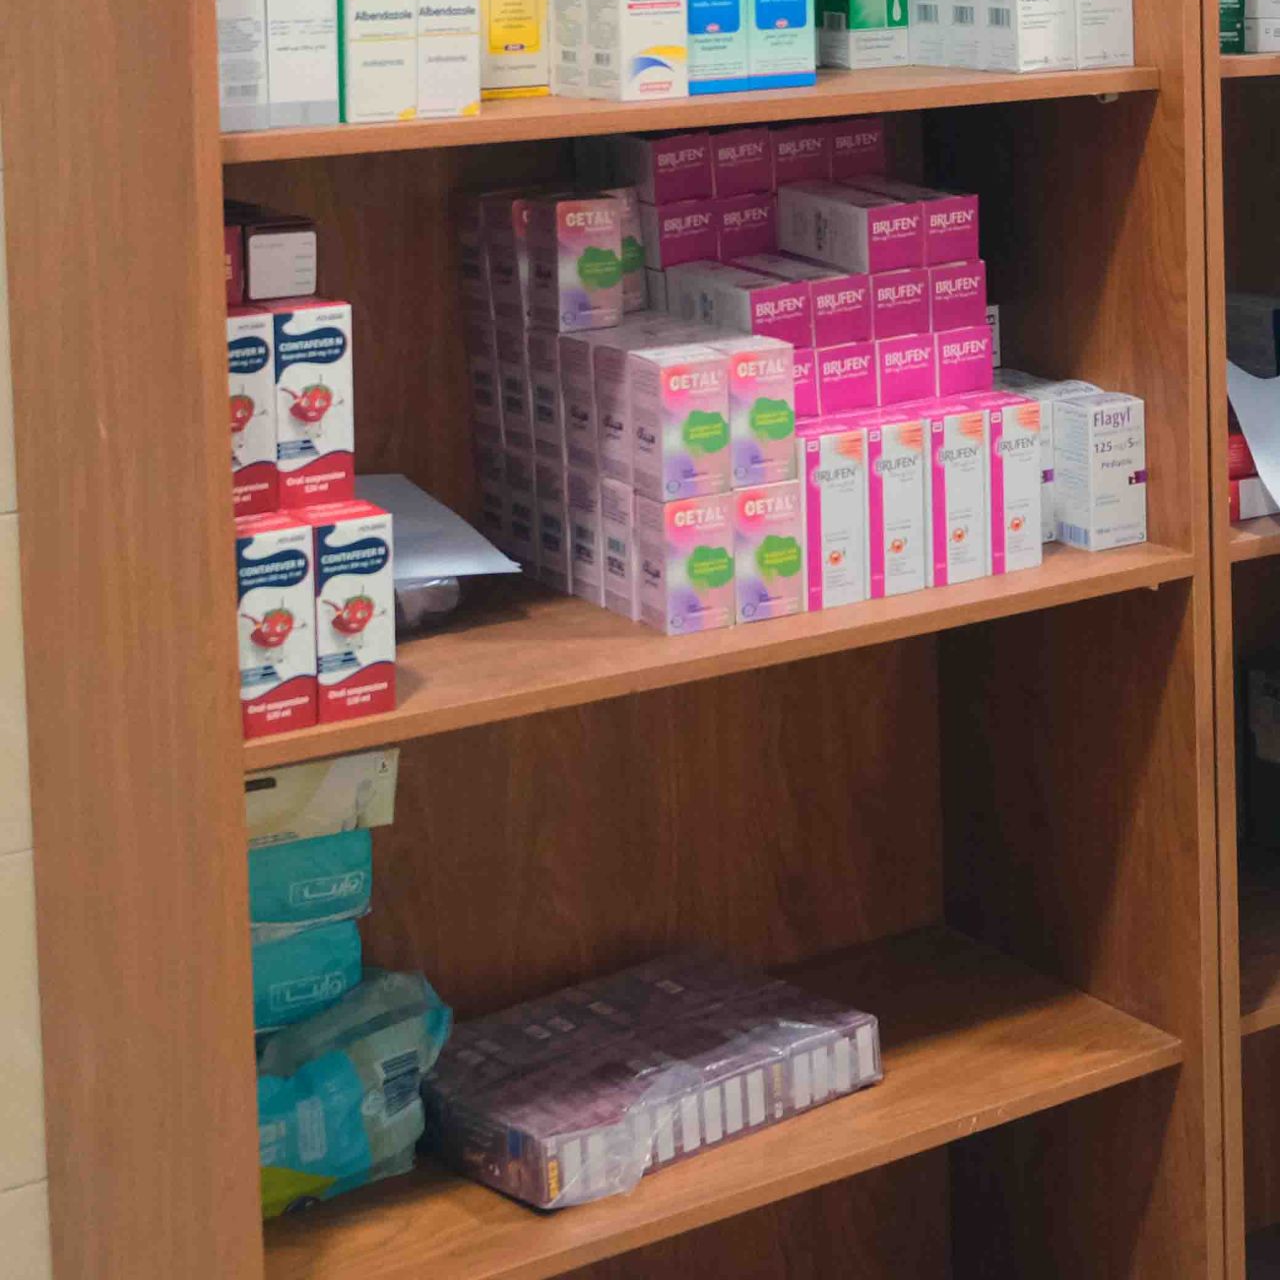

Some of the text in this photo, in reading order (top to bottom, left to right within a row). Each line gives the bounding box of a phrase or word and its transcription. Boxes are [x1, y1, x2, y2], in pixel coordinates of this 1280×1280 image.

[873, 217, 917, 235] BRUFEN
[930, 210, 973, 227] BRUFEN
[877, 283, 921, 302] BRUFEN
[935, 277, 979, 294] BRUFEN
[756, 298, 802, 317] BRUFEN
[817, 290, 863, 309] BRUFEN
[885, 348, 929, 366] BRUFEN
[943, 339, 987, 357] BRUFEN
[823, 356, 868, 375] BRUFEN
[1094, 406, 1130, 428] Flagyl
[1095, 441, 1112, 454] 125
